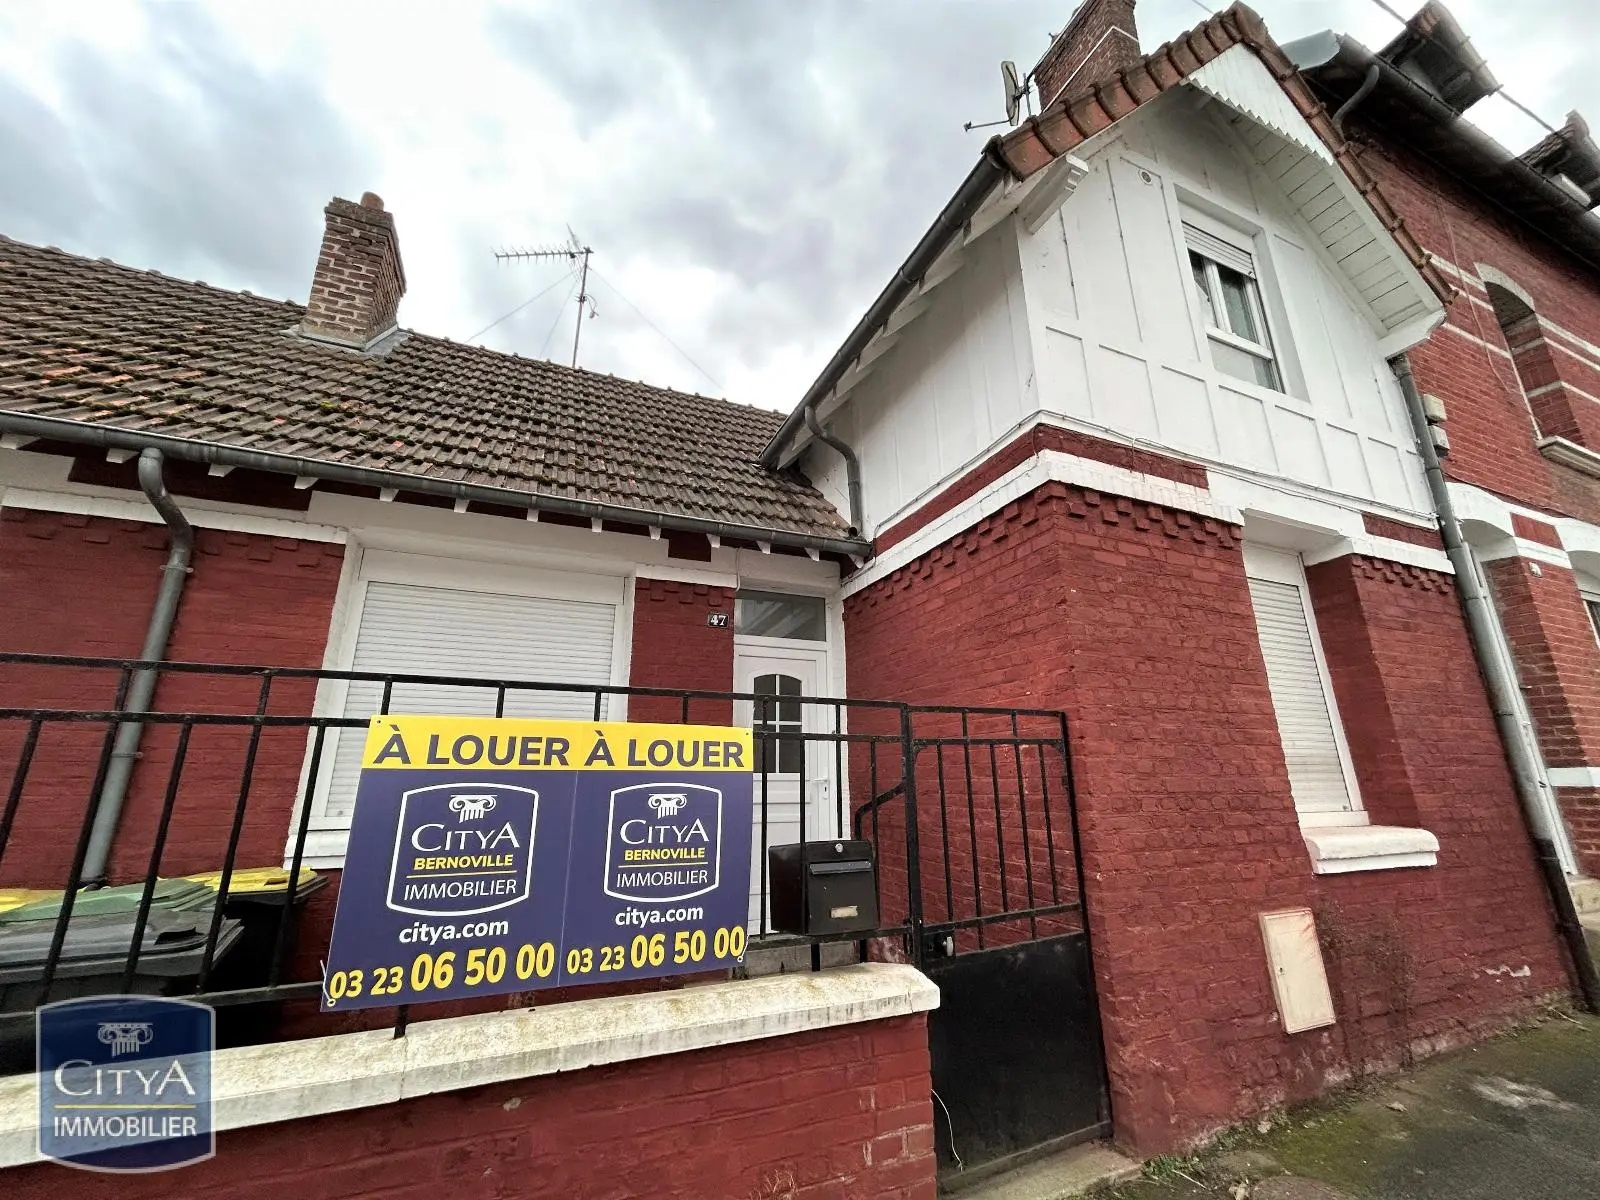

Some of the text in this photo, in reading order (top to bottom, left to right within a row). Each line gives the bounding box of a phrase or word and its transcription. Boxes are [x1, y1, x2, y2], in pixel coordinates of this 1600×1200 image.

[710, 614, 727, 626] 47
[373, 725, 570, 767] À LOUER
[584, 730, 744, 768] À LOUER
[413, 854, 514, 871] BERNOVILLE
[624, 847, 706, 862] BERNOVILLE
[403, 879, 517, 901] IMMOBILIER
[616, 869, 708, 888] IMMOBILIER
[615, 906, 704, 929] citya.com
[399, 920, 509, 945] citya.com
[566, 925, 746, 975] 03 23 06 50 00
[329, 942, 555, 999] 03 23 06 50 00
